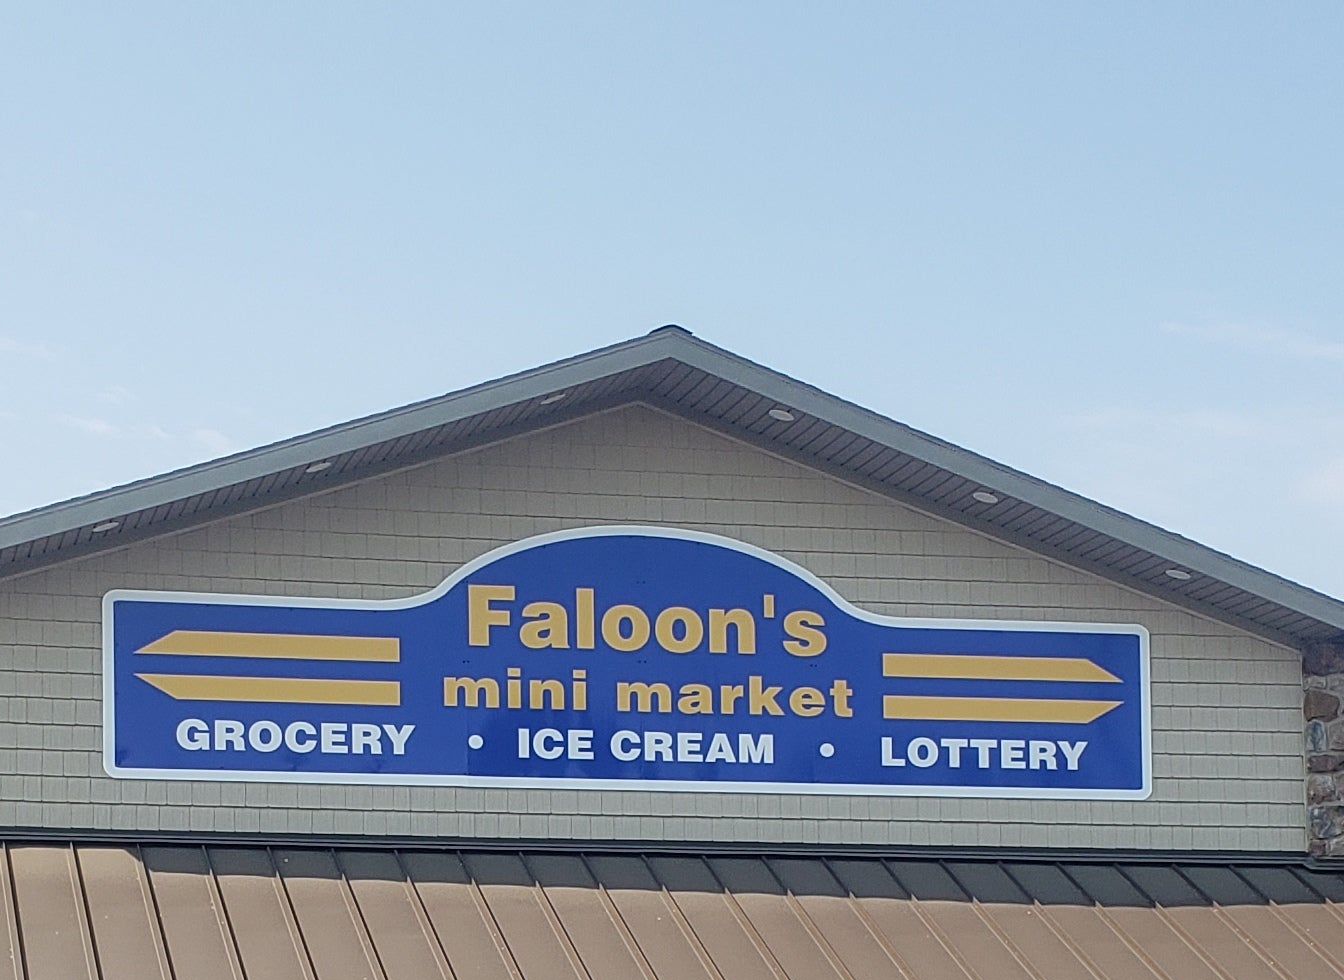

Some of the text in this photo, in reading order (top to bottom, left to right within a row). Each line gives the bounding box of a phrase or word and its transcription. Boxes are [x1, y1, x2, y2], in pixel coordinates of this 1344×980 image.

[468, 584, 827, 656] Faloon's
[444, 668, 853, 717] mini market
[176, 718, 1088, 771] GROCERY ICE CREAM LOTTERY
